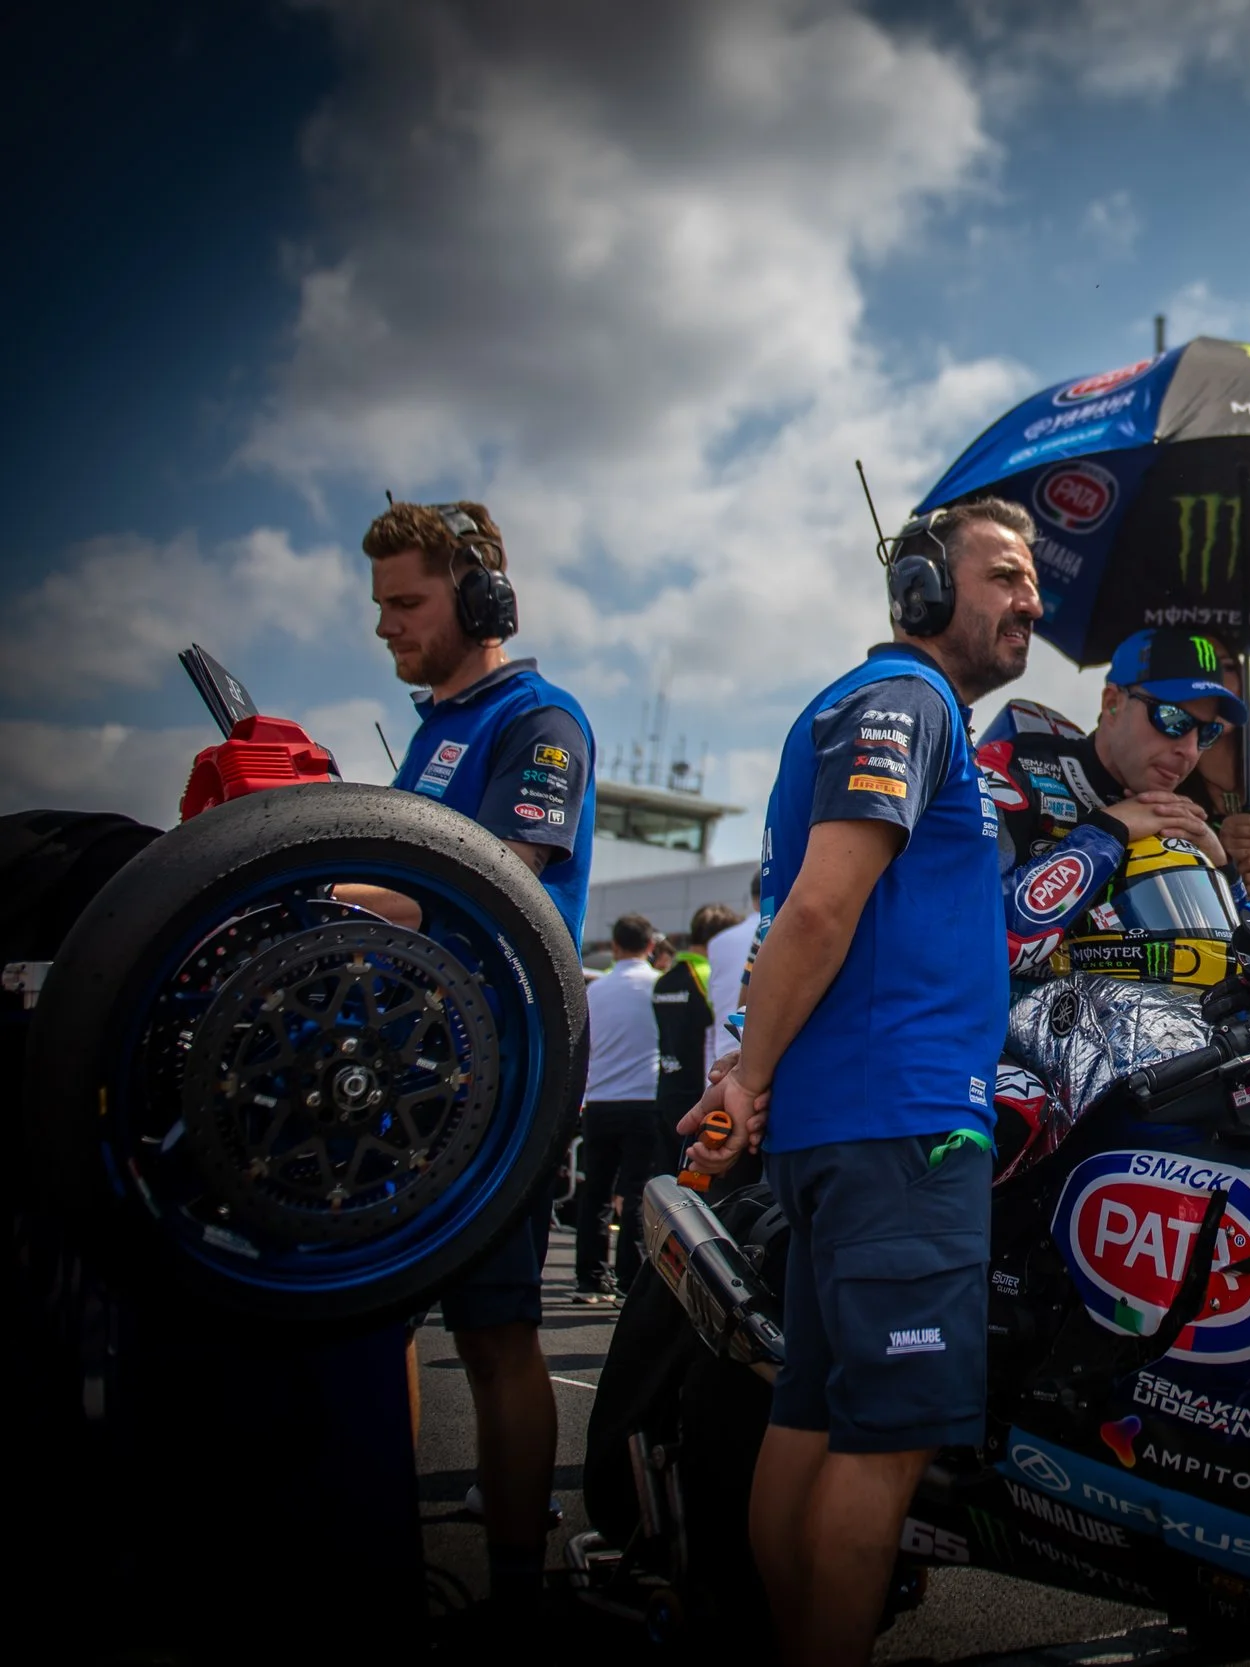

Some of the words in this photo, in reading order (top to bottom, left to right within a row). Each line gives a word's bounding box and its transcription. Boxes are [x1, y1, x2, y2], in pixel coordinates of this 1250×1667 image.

[1053, 477, 1100, 514] PATA
[860, 727, 909, 748] YAMALUBE
[522, 770, 548, 783] SRG
[853, 778, 903, 796] PIRELLI
[520, 807, 540, 818] HEL
[1031, 861, 1077, 908] PATA
[1215, 930, 1233, 939] Insta
[1073, 946, 1144, 961] MONSTER
[1082, 960, 1133, 969] ENERGY
[1132, 1155, 1235, 1192] SNACK
[1094, 1198, 1240, 1291] PATA
[991, 1269, 1020, 1289] SUTER
[889, 1327, 942, 1347] YAMALUBE
[1132, 1385, 1159, 1410] DI
[1003, 1479, 1134, 1550] YAMALUBE
[900, 1517, 970, 1563] 65
[1017, 1530, 1156, 1602] MONSTER
